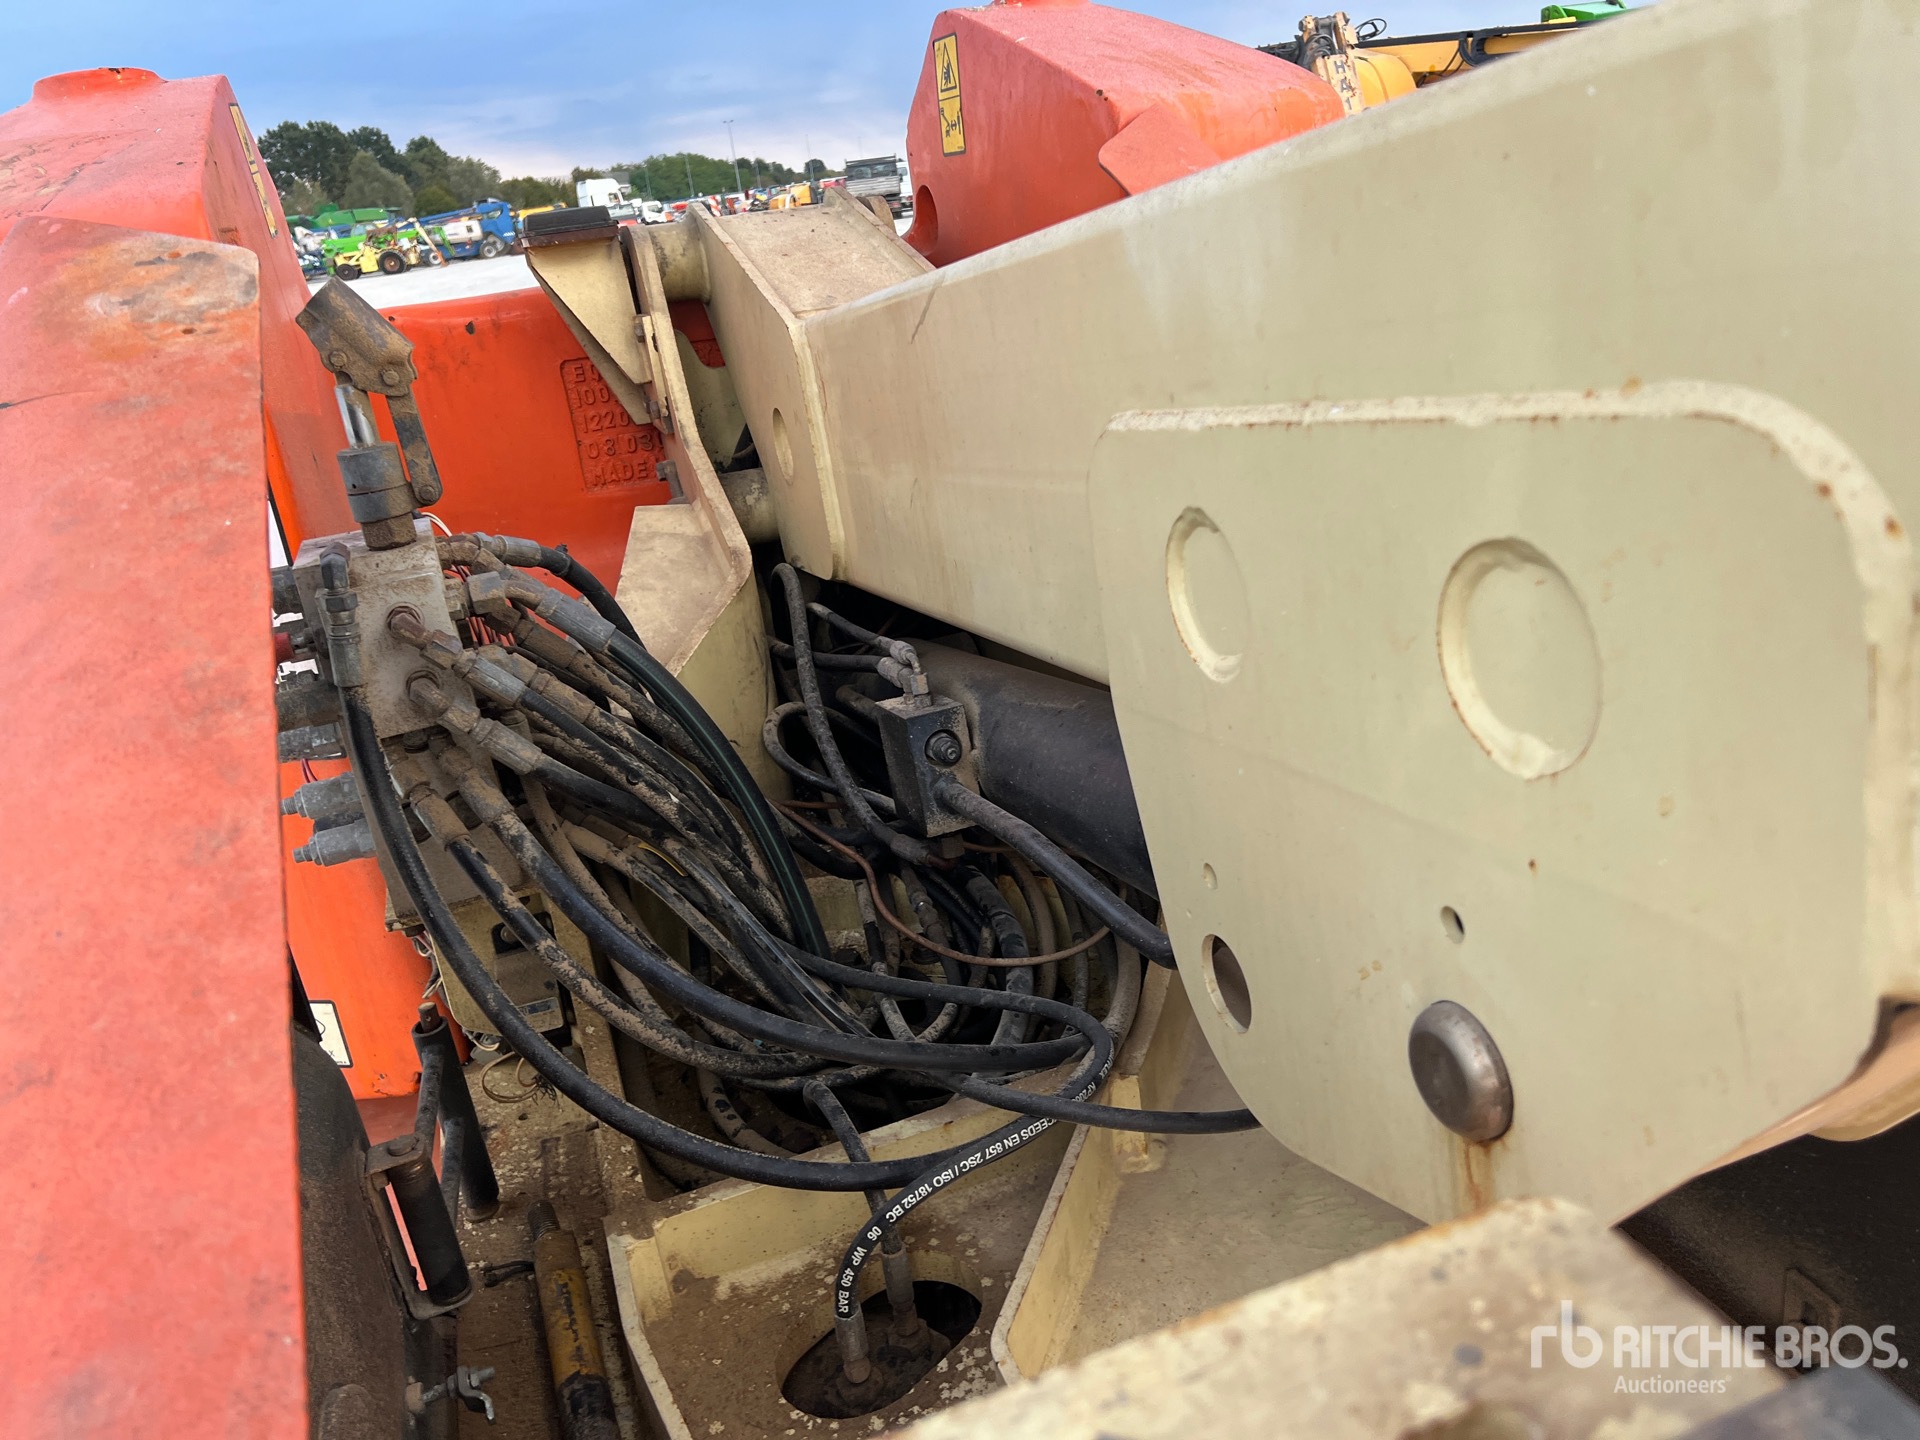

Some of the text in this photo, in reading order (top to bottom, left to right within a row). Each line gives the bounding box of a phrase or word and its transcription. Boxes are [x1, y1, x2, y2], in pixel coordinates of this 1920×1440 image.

[575, 385, 619, 408] 100
[592, 461, 649, 487] MADE
[1071, 1081, 1096, 1103] KP200
[985, 1142, 1003, 1160] 857
[1005, 1133, 1020, 1149] EN
[960, 1153, 983, 1172] 2SC
[933, 1168, 955, 1188] ISO
[902, 1183, 933, 1208] 18752
[885, 1204, 904, 1223] BC
[866, 1226, 882, 1241] 06
[851, 1246, 867, 1266] WP
[840, 1267, 855, 1287] 450
[838, 1289, 850, 1313] BAR
